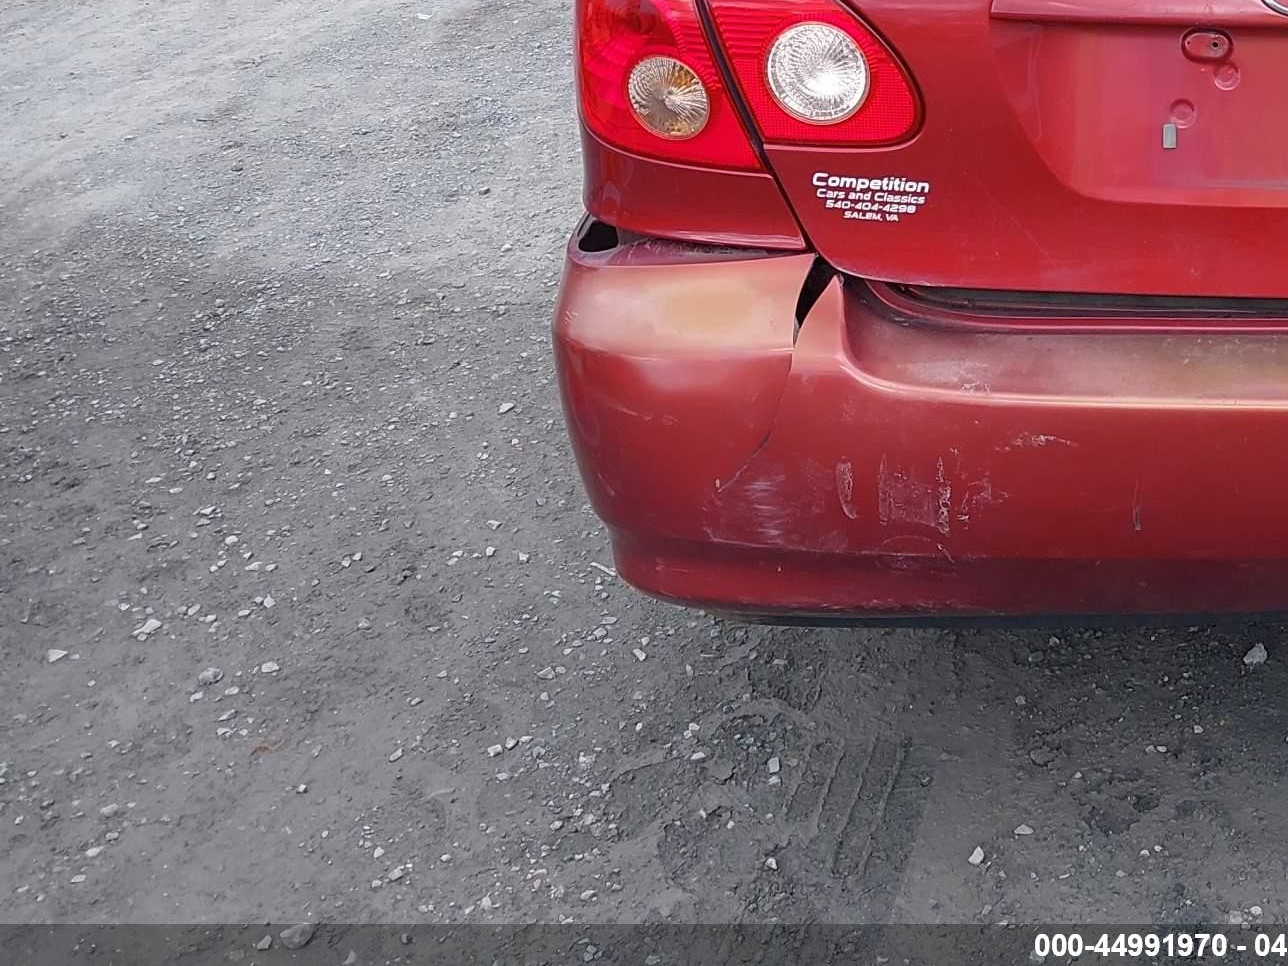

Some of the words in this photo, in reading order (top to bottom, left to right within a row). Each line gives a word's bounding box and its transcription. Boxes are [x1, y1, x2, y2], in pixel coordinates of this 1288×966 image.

[812, 172, 930, 193] Competition
[816, 188, 846, 199] Cars
[848, 191, 871, 201] and
[874, 192, 926, 204] Classics
[825, 199, 917, 214] 540-404-4298
[885, 213, 899, 222] VA
